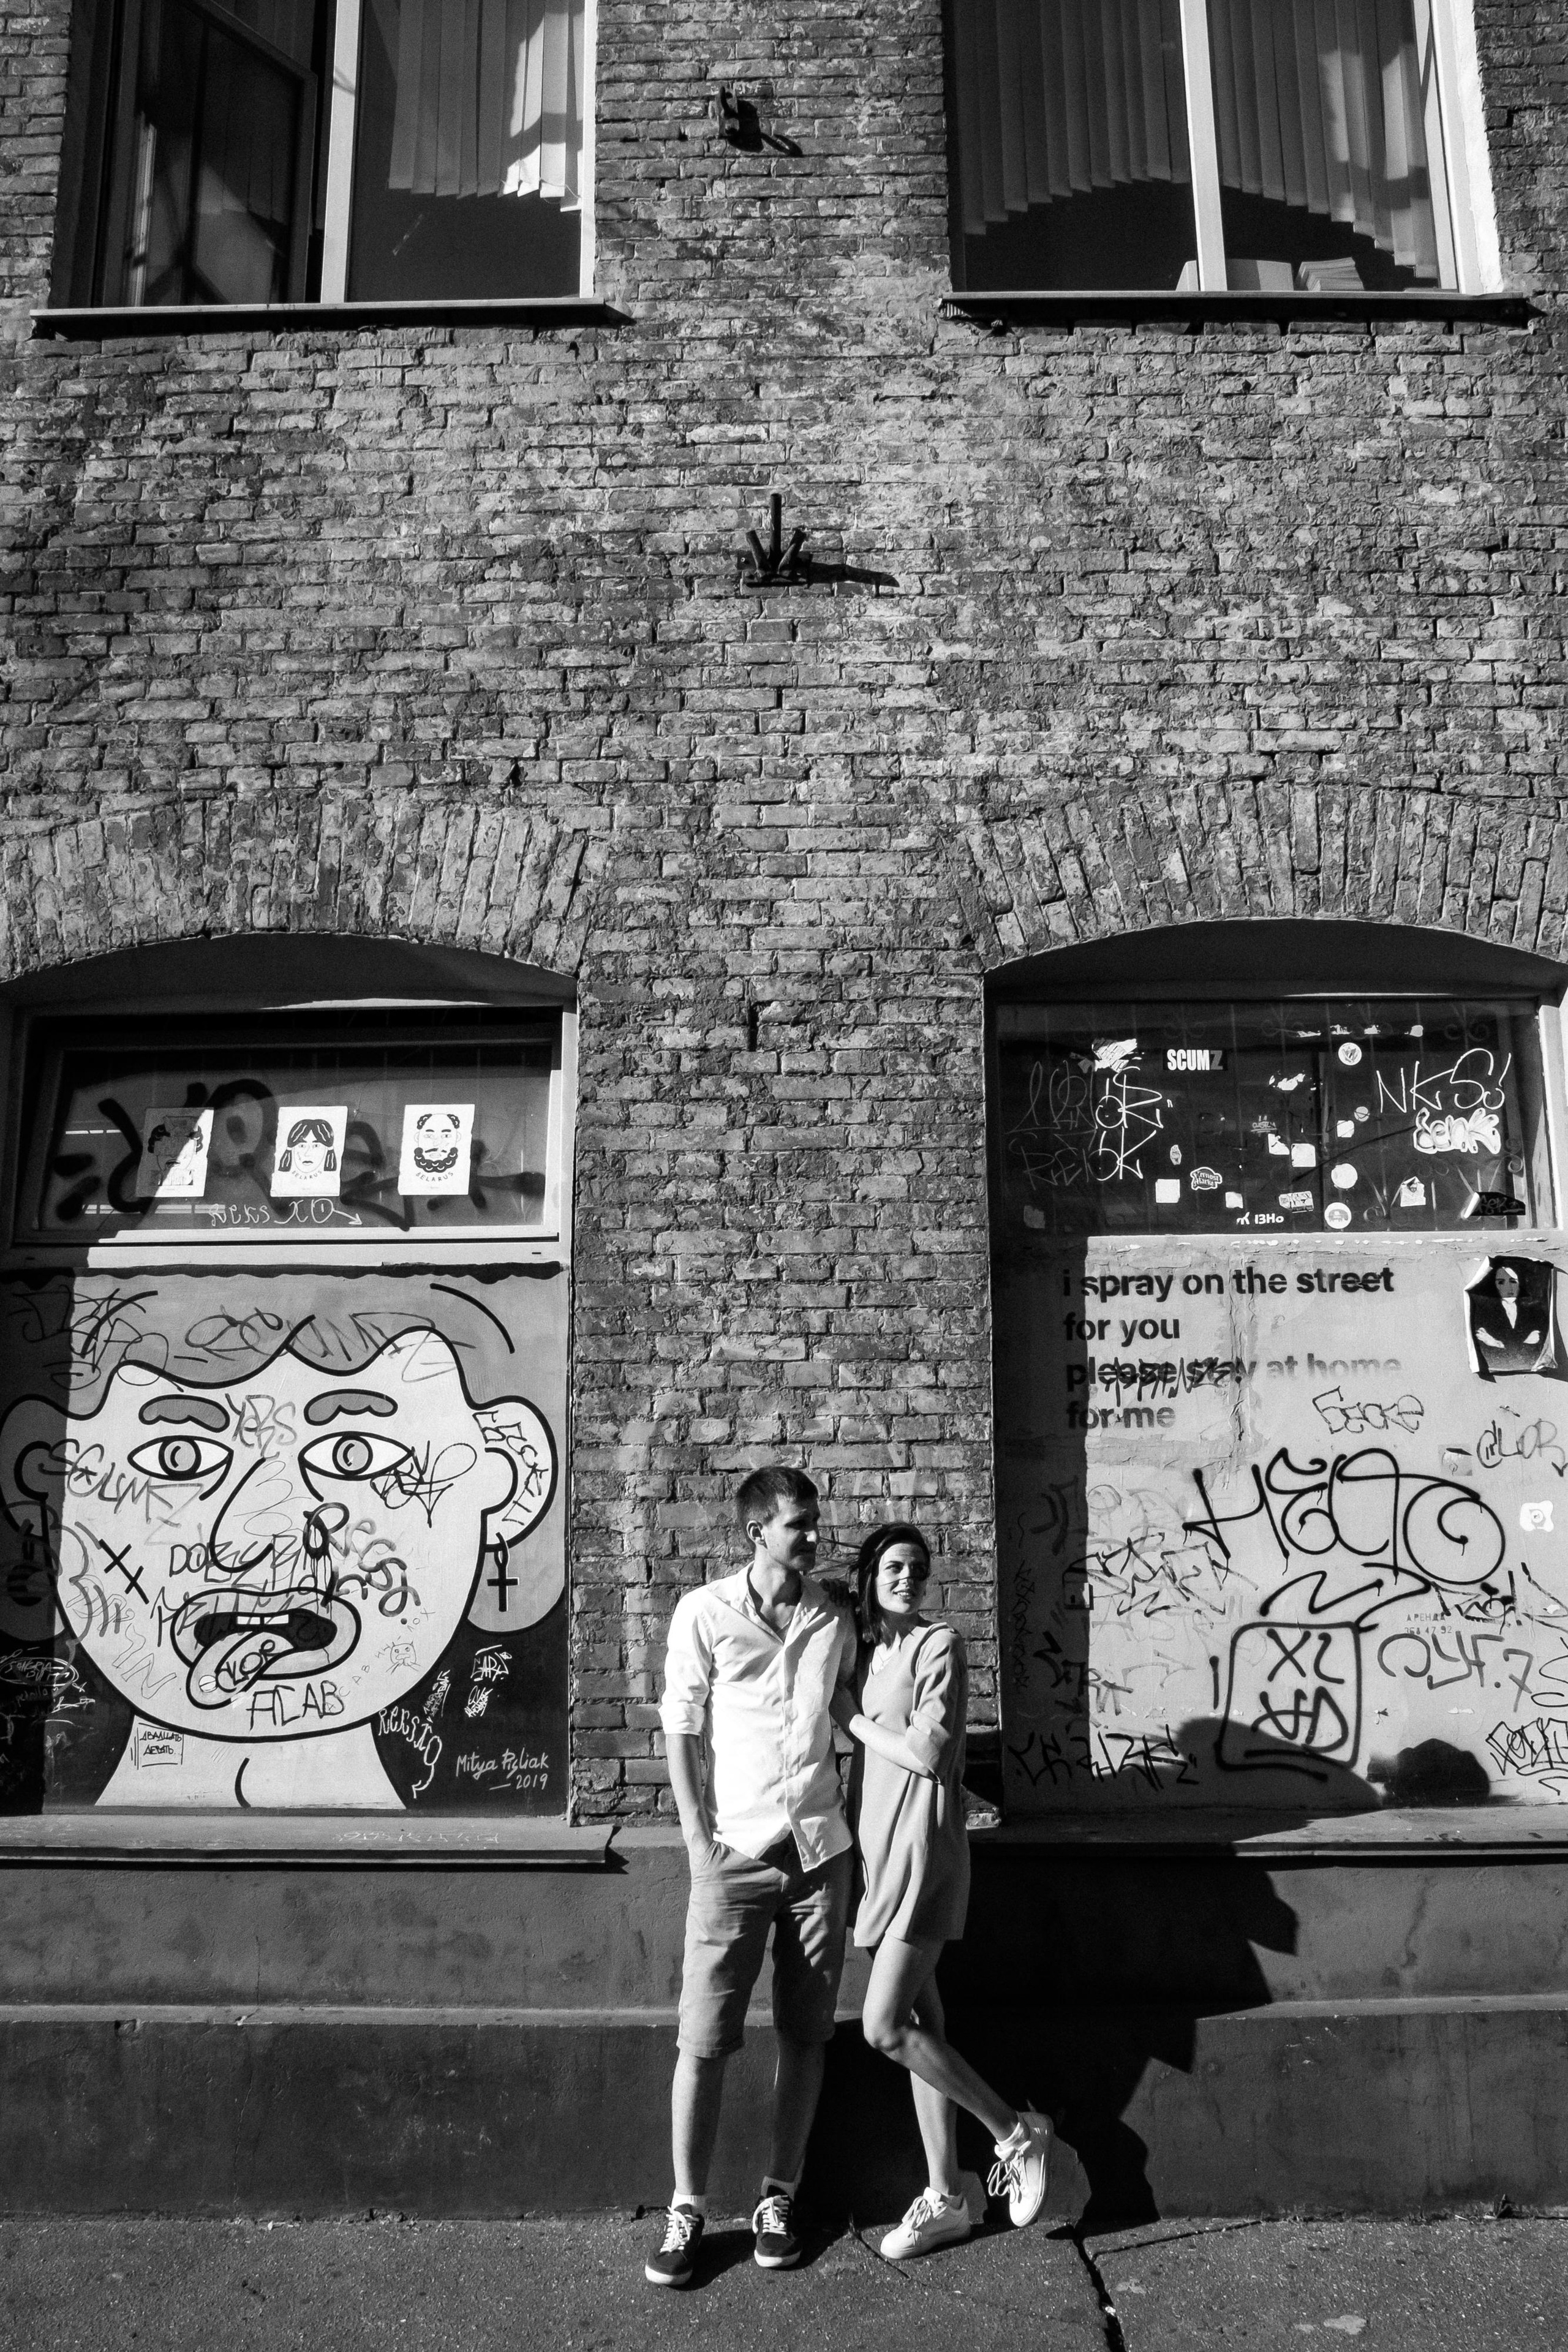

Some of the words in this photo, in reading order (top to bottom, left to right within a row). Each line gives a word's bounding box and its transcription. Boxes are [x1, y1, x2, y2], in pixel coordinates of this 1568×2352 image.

[1166, 1049, 1223, 1071] SCUMZ
[415, 1171, 454, 1182] BELARUS
[1063, 1268, 1070, 1296] i
[1080, 1273, 1174, 1303] spray
[1183, 1273, 1224, 1295] on
[1232, 1266, 1287, 1295] the
[1296, 1267, 1394, 1294] street
[1063, 1312, 1111, 1341] for
[1120, 1318, 1180, 1348] you
[1066, 1356, 1177, 1392] please
[1266, 1354, 1298, 1381] at
[1307, 1352, 1401, 1381] home
[1065, 1400, 1114, 1429] for
[1123, 1406, 1176, 1428] me
[456, 1751, 498, 1780] Mitya
[516, 1773, 549, 1790] 2019
